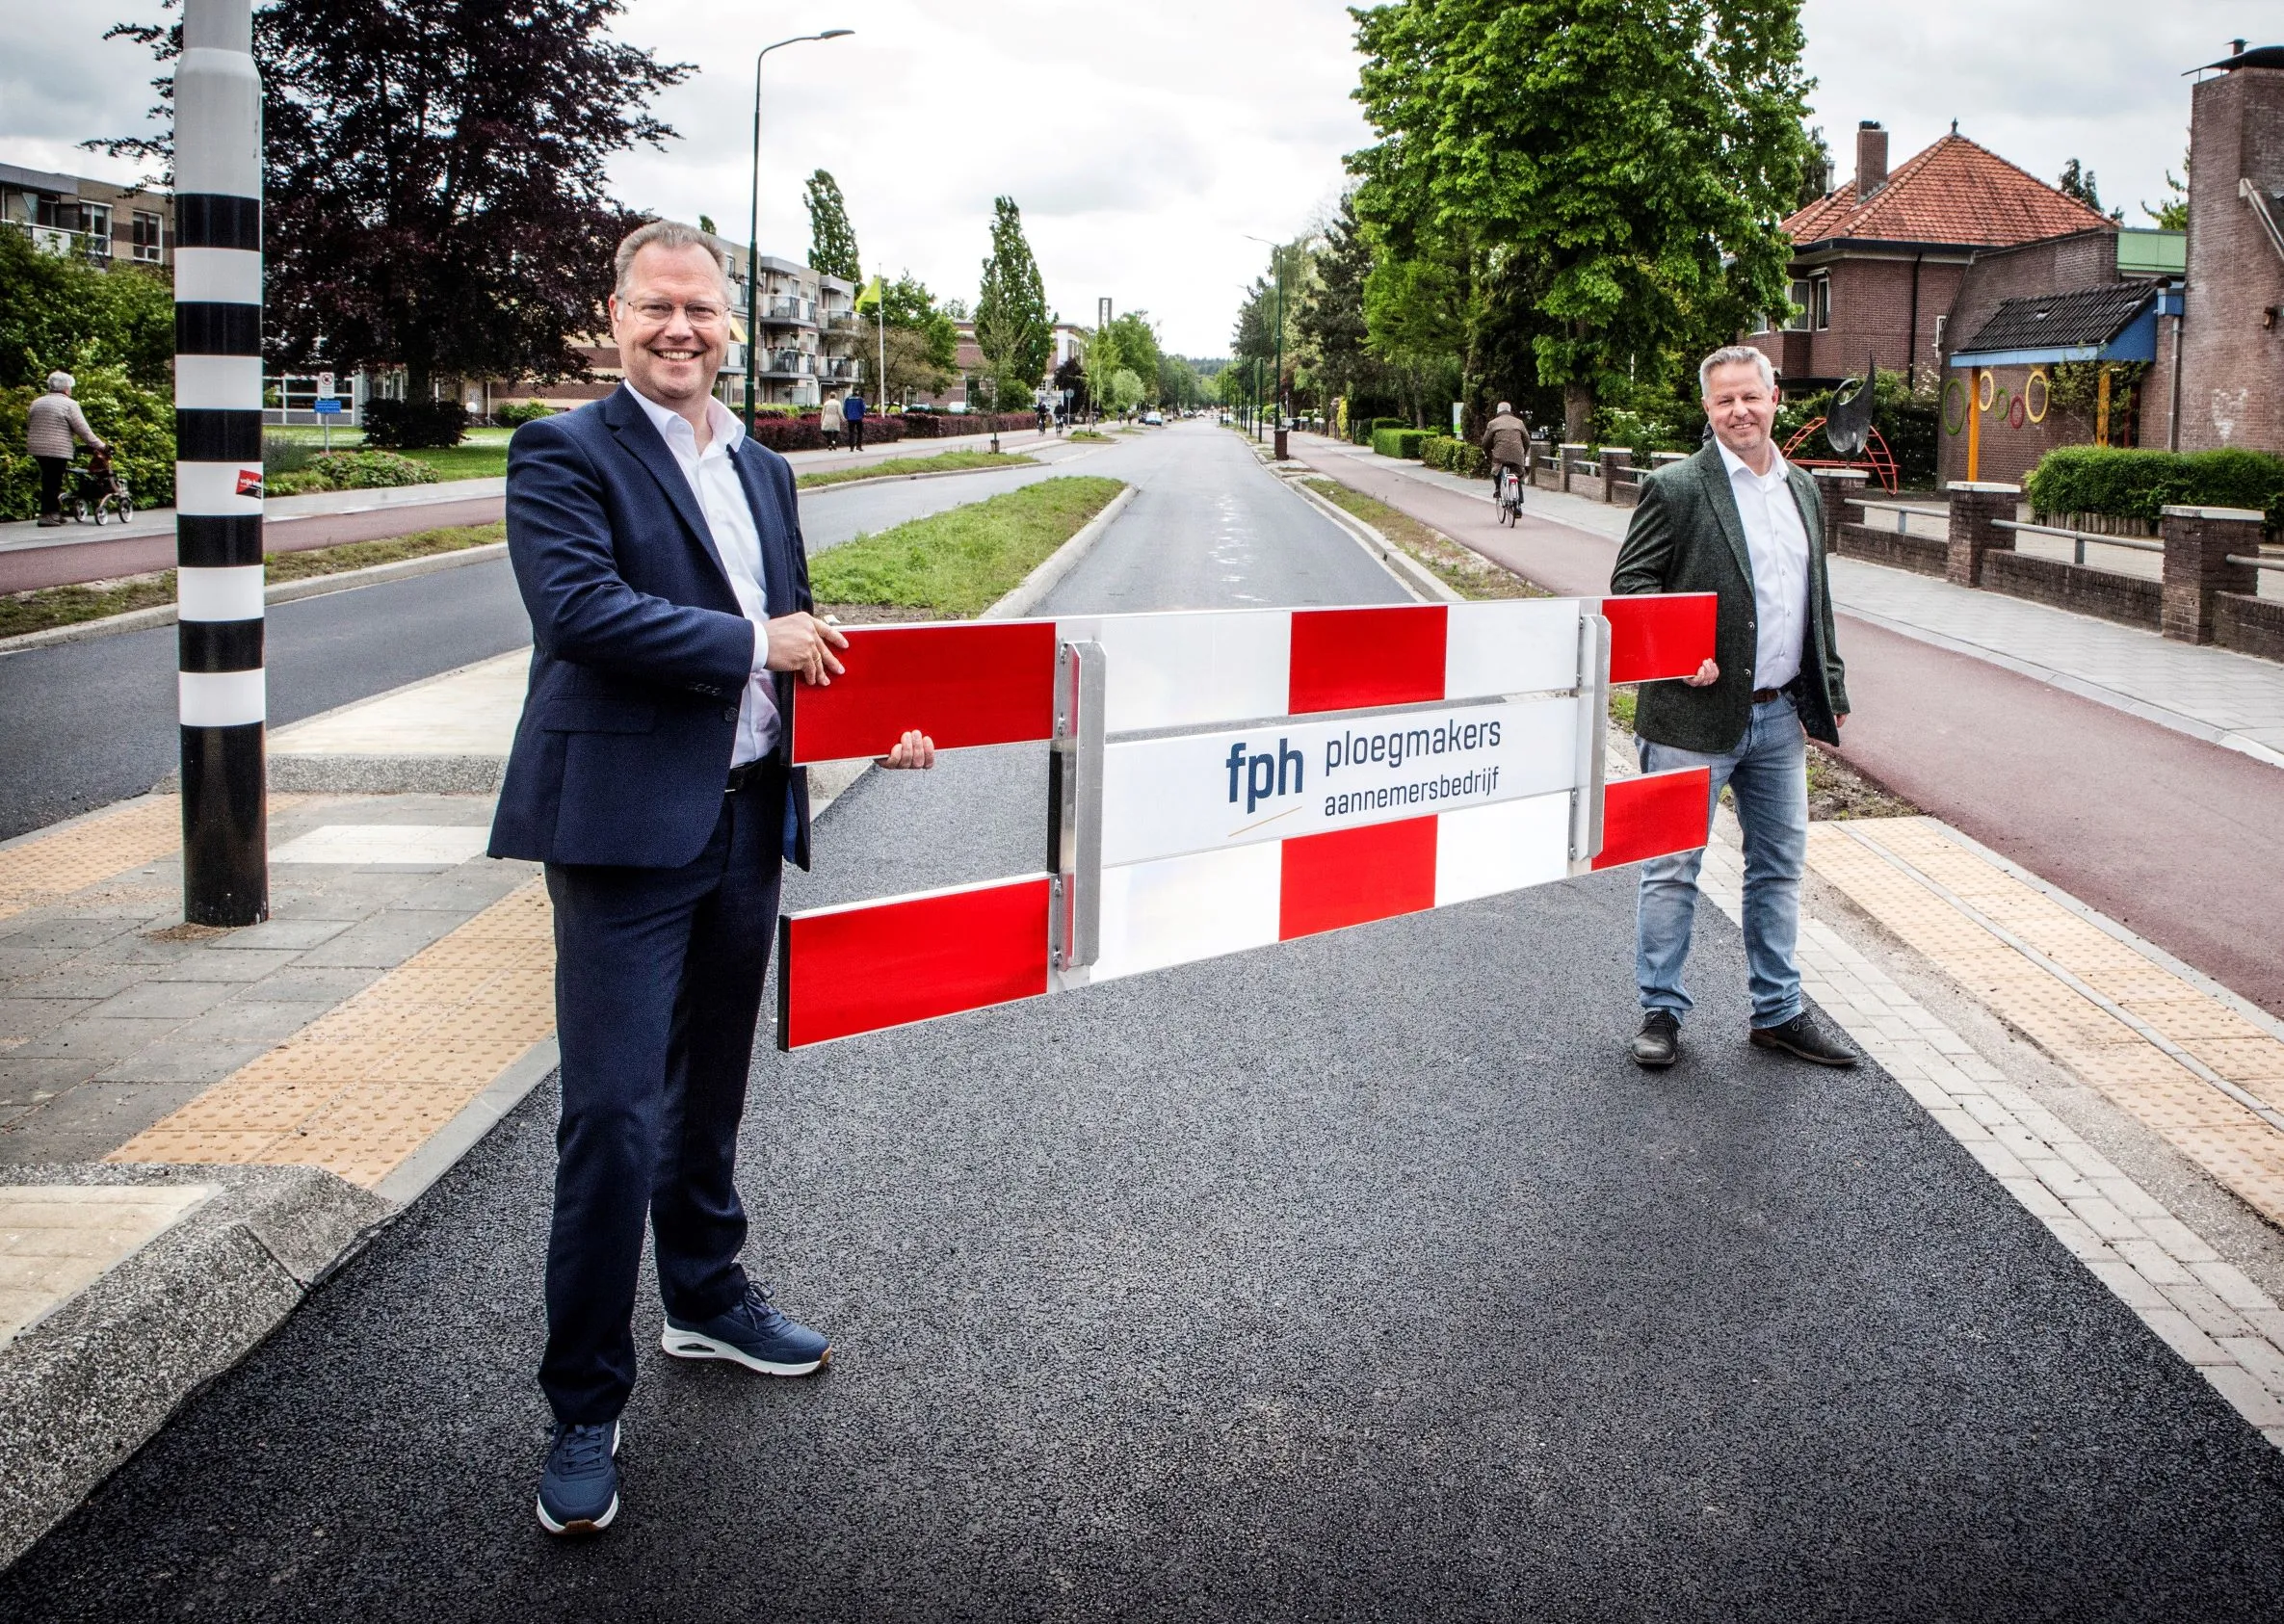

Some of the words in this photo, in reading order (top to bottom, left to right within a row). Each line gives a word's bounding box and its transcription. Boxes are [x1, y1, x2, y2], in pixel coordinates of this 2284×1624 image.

[1226, 738, 1303, 814] fph
[1326, 720, 1501, 776] ploegmakers
[1325, 767, 1499, 816] aannemersbedrijf
